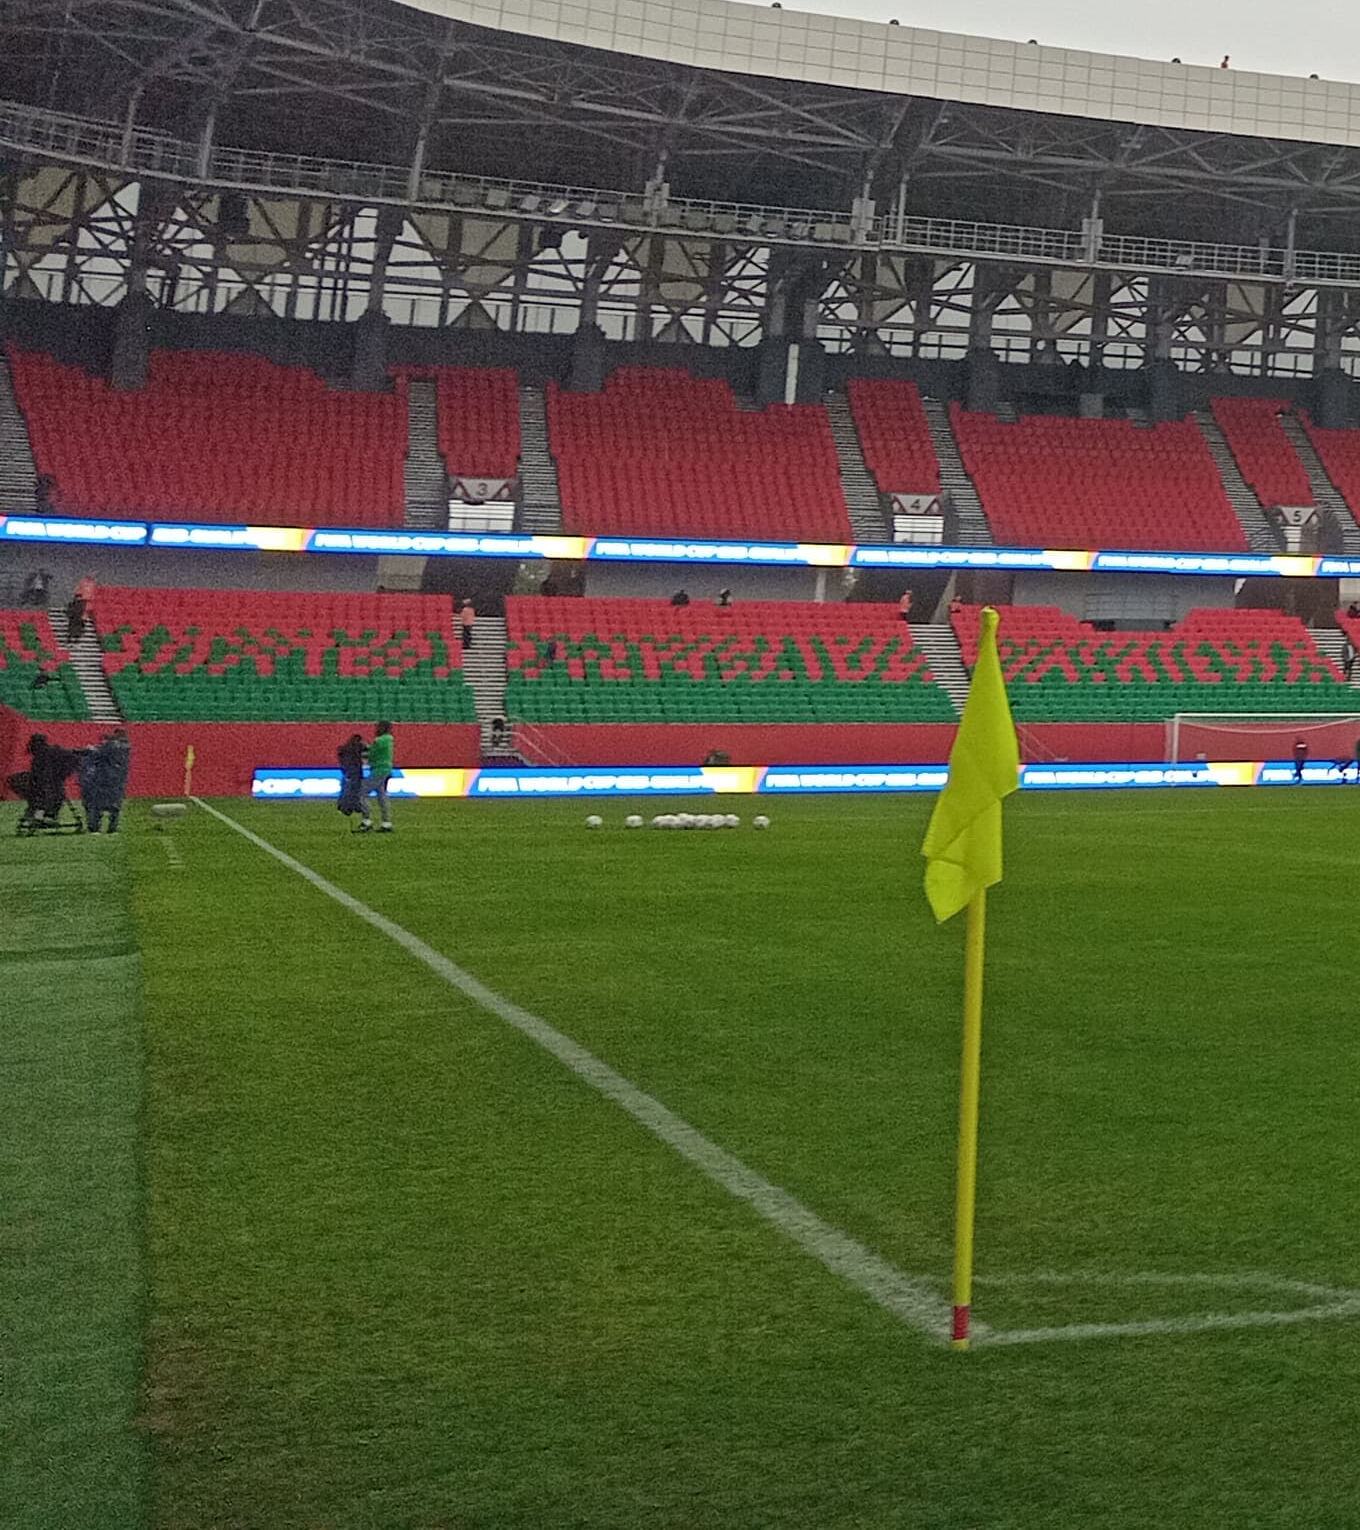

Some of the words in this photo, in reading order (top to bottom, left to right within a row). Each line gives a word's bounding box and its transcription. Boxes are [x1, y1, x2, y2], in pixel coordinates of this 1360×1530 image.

[476, 482, 488, 496] 3
[910, 498, 921, 511] 4
[1292, 510, 1302, 522] 5
